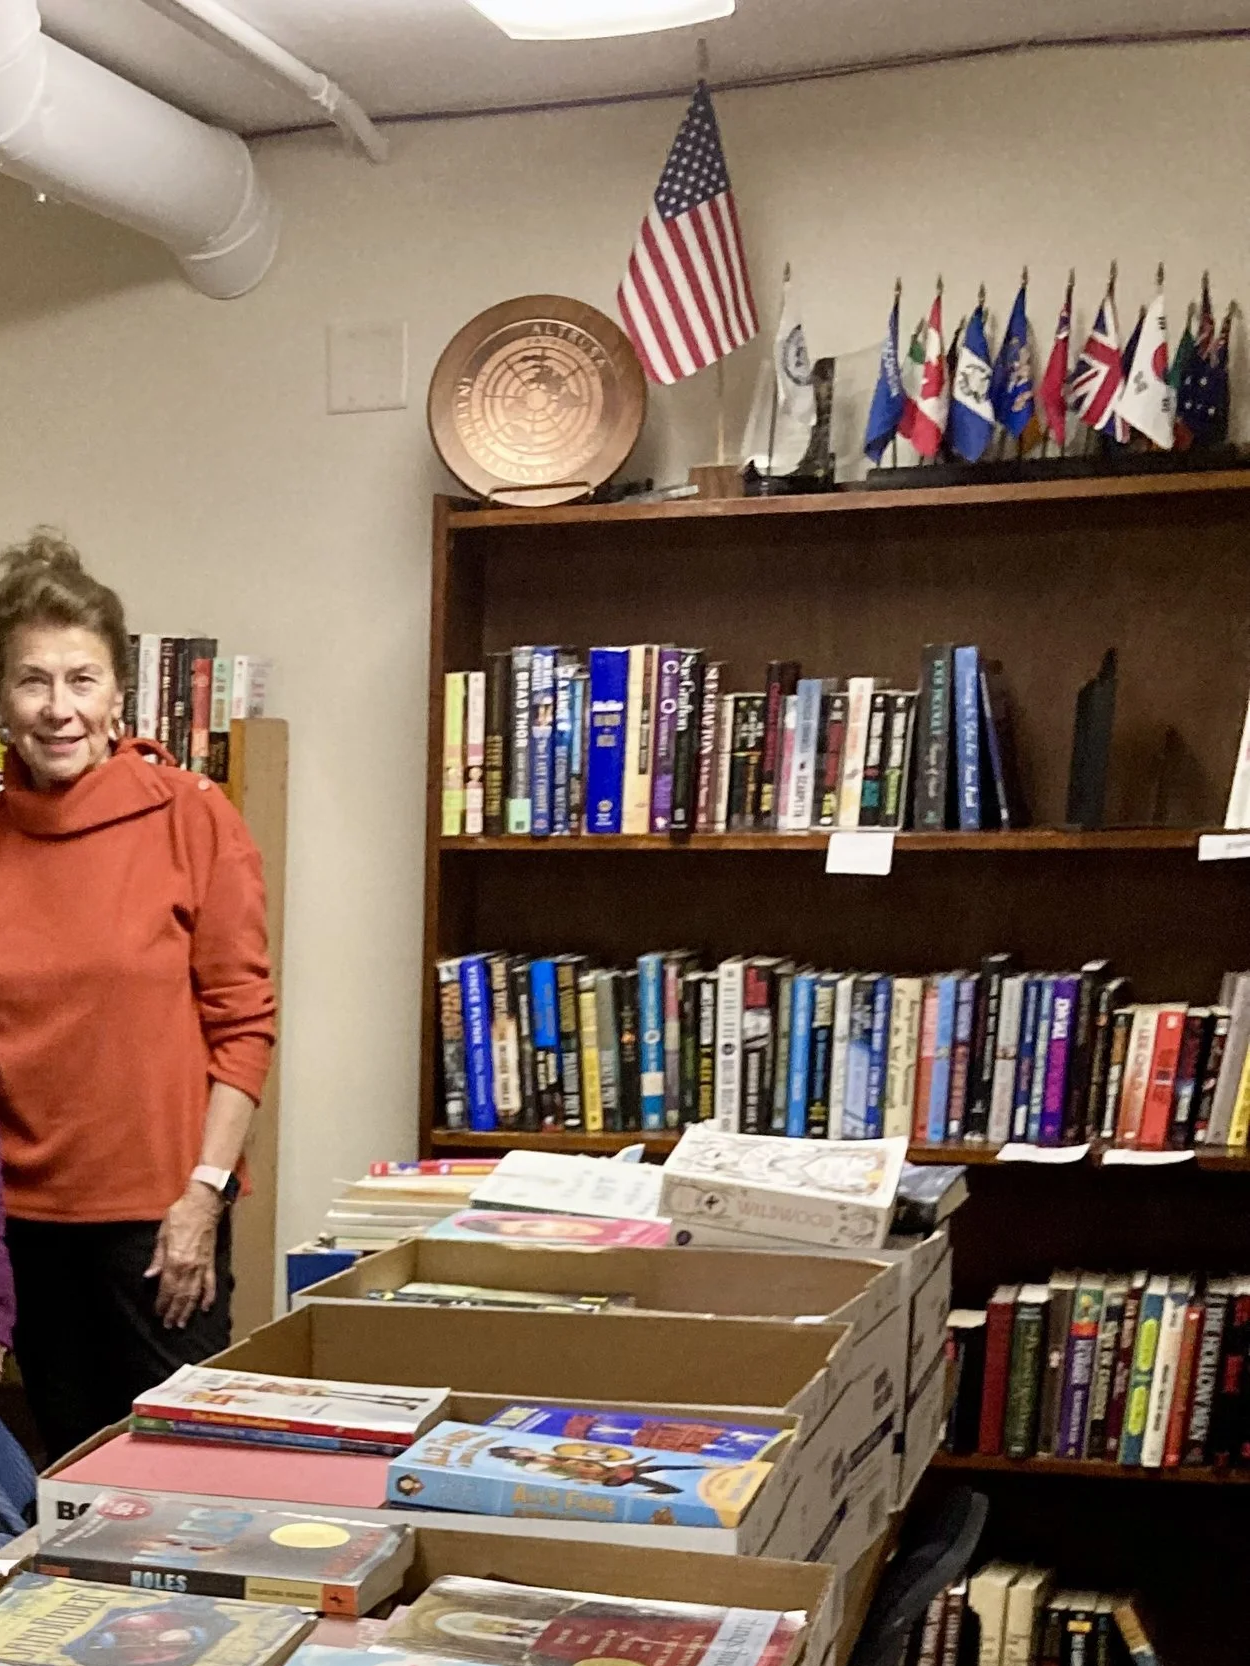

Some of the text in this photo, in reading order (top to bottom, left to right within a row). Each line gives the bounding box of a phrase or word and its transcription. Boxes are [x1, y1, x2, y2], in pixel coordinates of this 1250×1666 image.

[516, 672, 529, 709] BRAD
[676, 680, 695, 731] Grafton
[516, 713, 529, 747] THOR
[700, 694, 717, 755] GRAFTON
[467, 965, 483, 1044] VINCE FLYNN
[737, 1201, 833, 1229] WILDWOOD
[130, 1570, 187, 1592] HOLES
